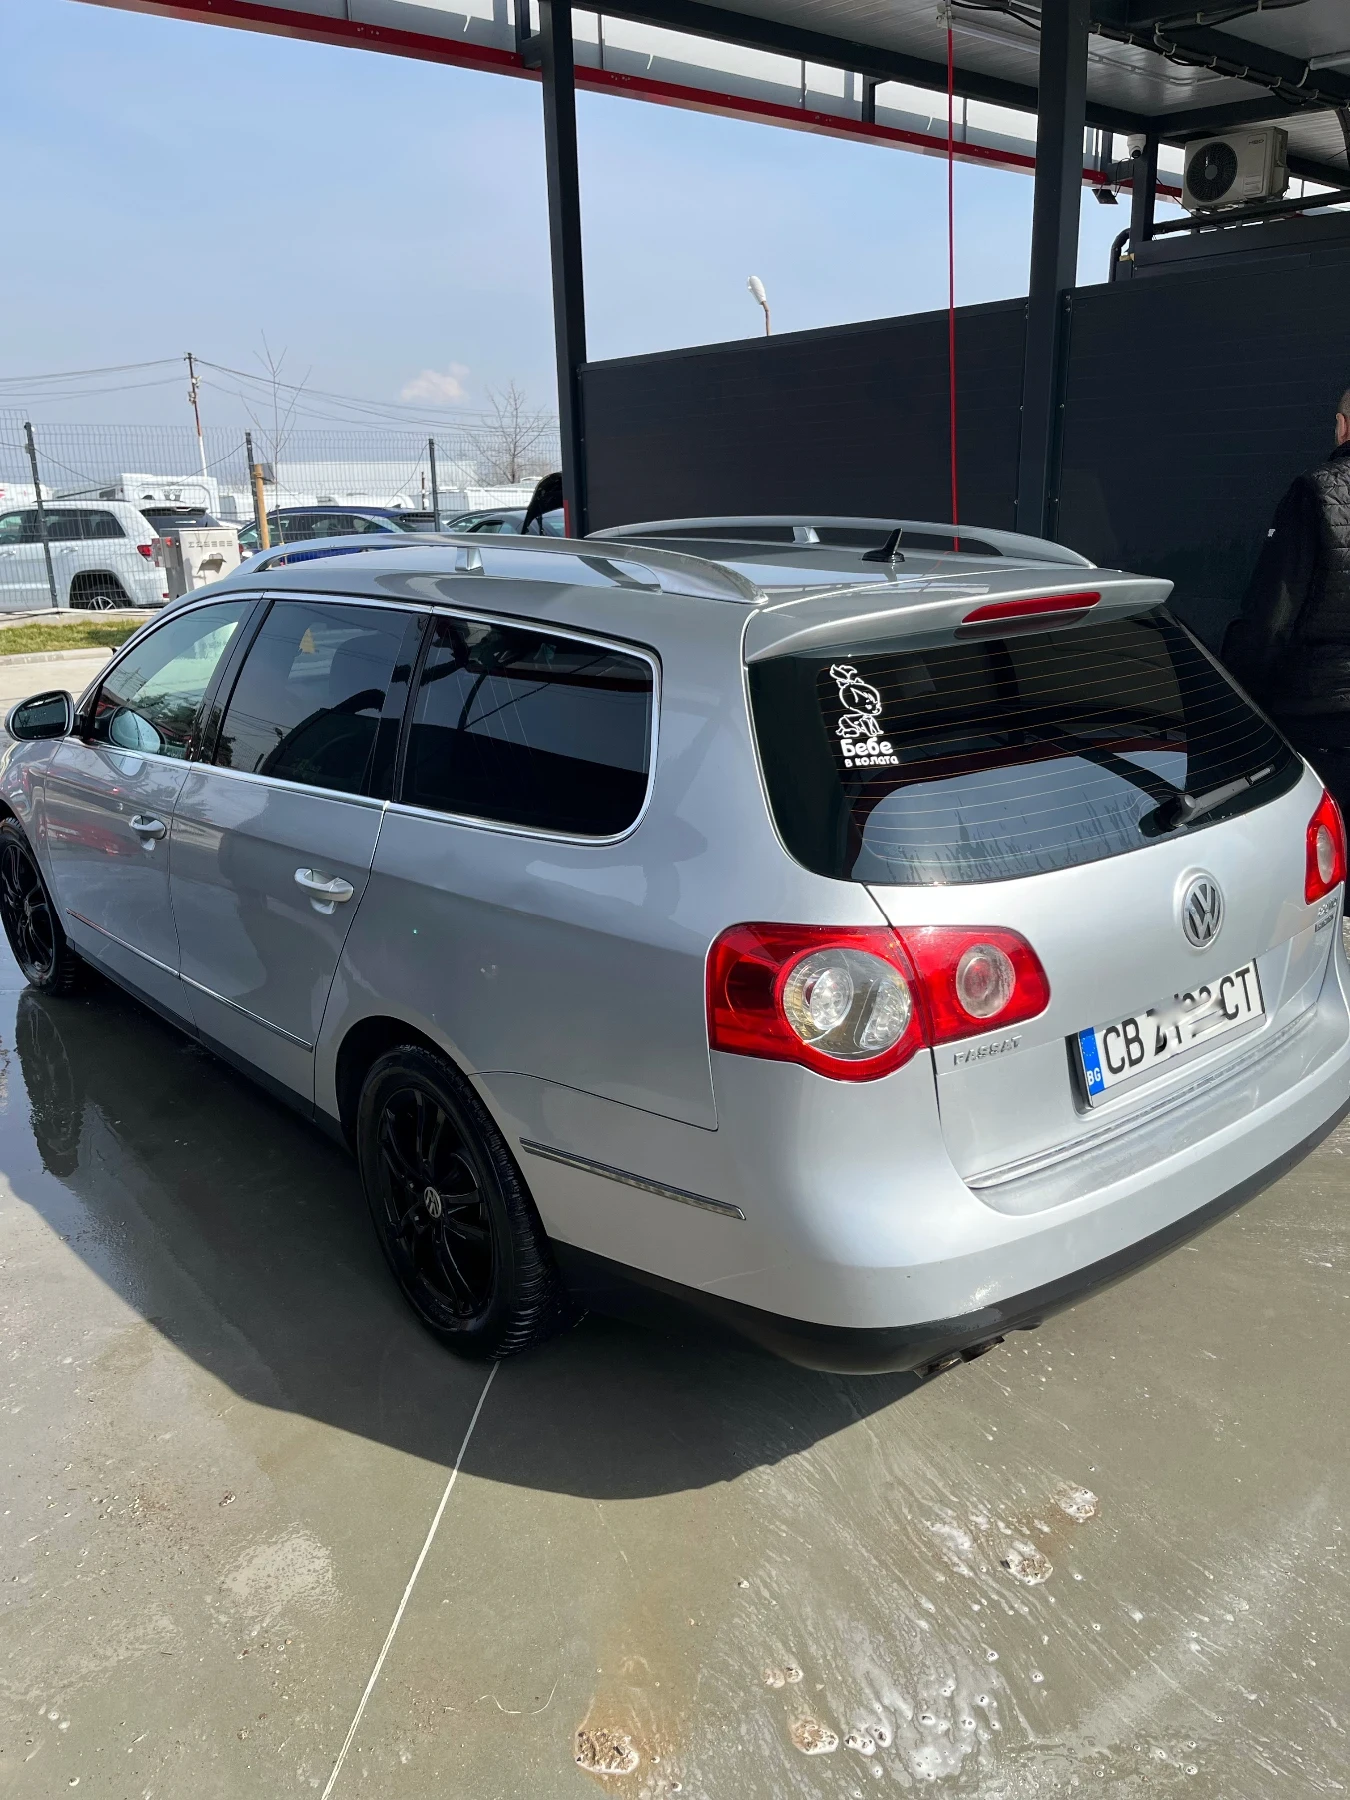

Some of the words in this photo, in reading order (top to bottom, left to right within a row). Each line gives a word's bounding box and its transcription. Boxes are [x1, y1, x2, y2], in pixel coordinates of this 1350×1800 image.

[840, 737, 894, 757] Бебе
[844, 758, 853, 768] в
[855, 755, 899, 766] колата
[953, 1034, 1023, 1067] PASSAT
[1087, 1067, 1102, 1086] BG
